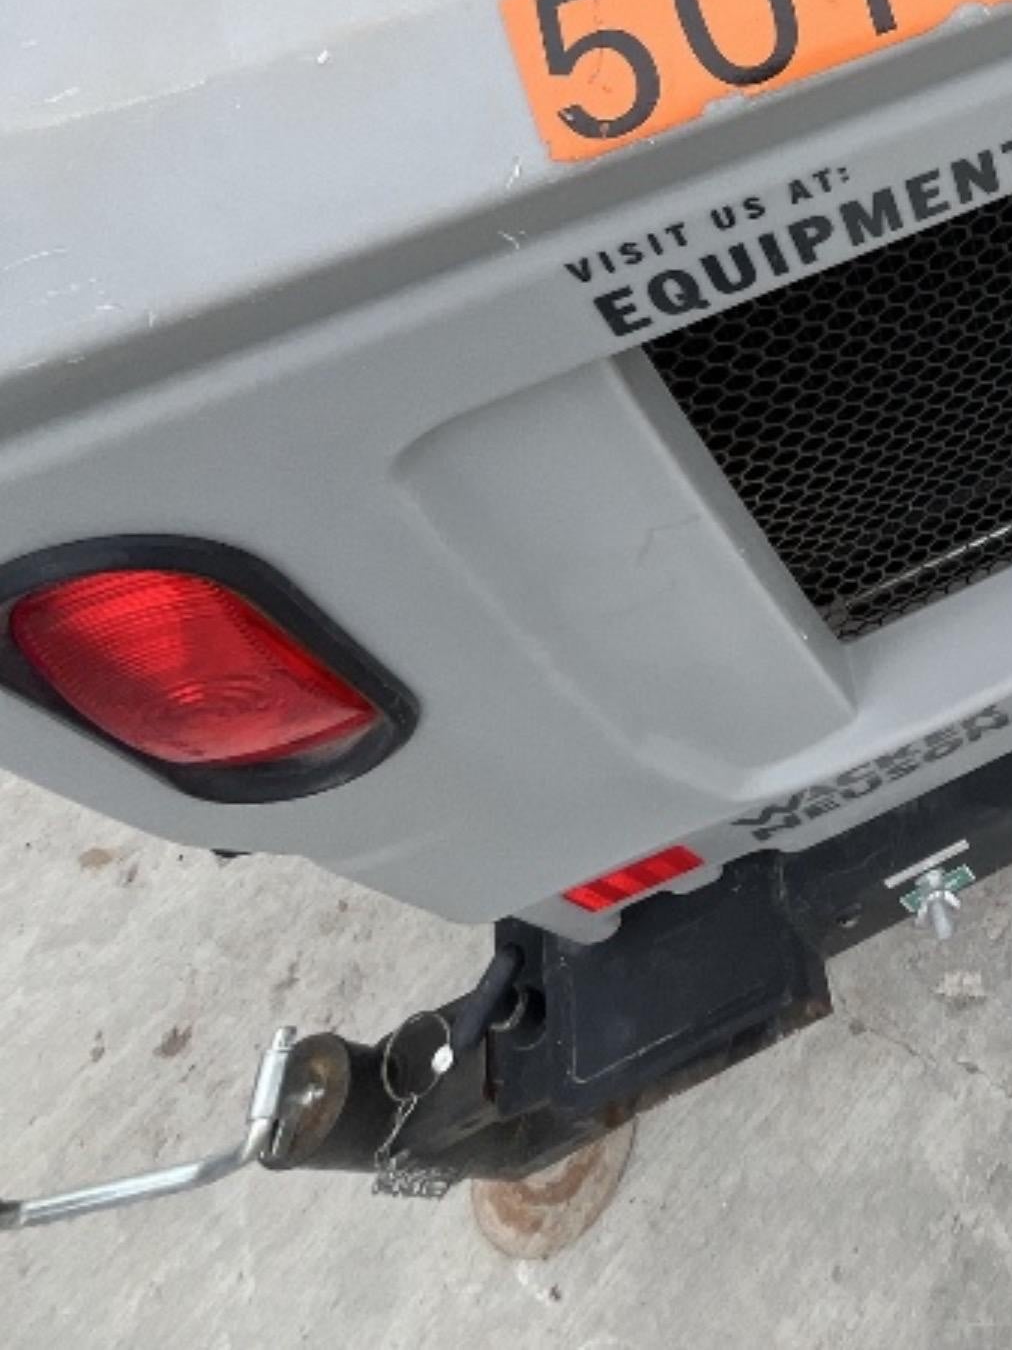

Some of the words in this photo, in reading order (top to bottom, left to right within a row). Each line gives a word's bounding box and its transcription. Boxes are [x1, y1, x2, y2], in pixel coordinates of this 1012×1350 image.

[566, 221, 688, 283] VISIT
[711, 196, 766, 231] US
[789, 164, 851, 205] AT:
